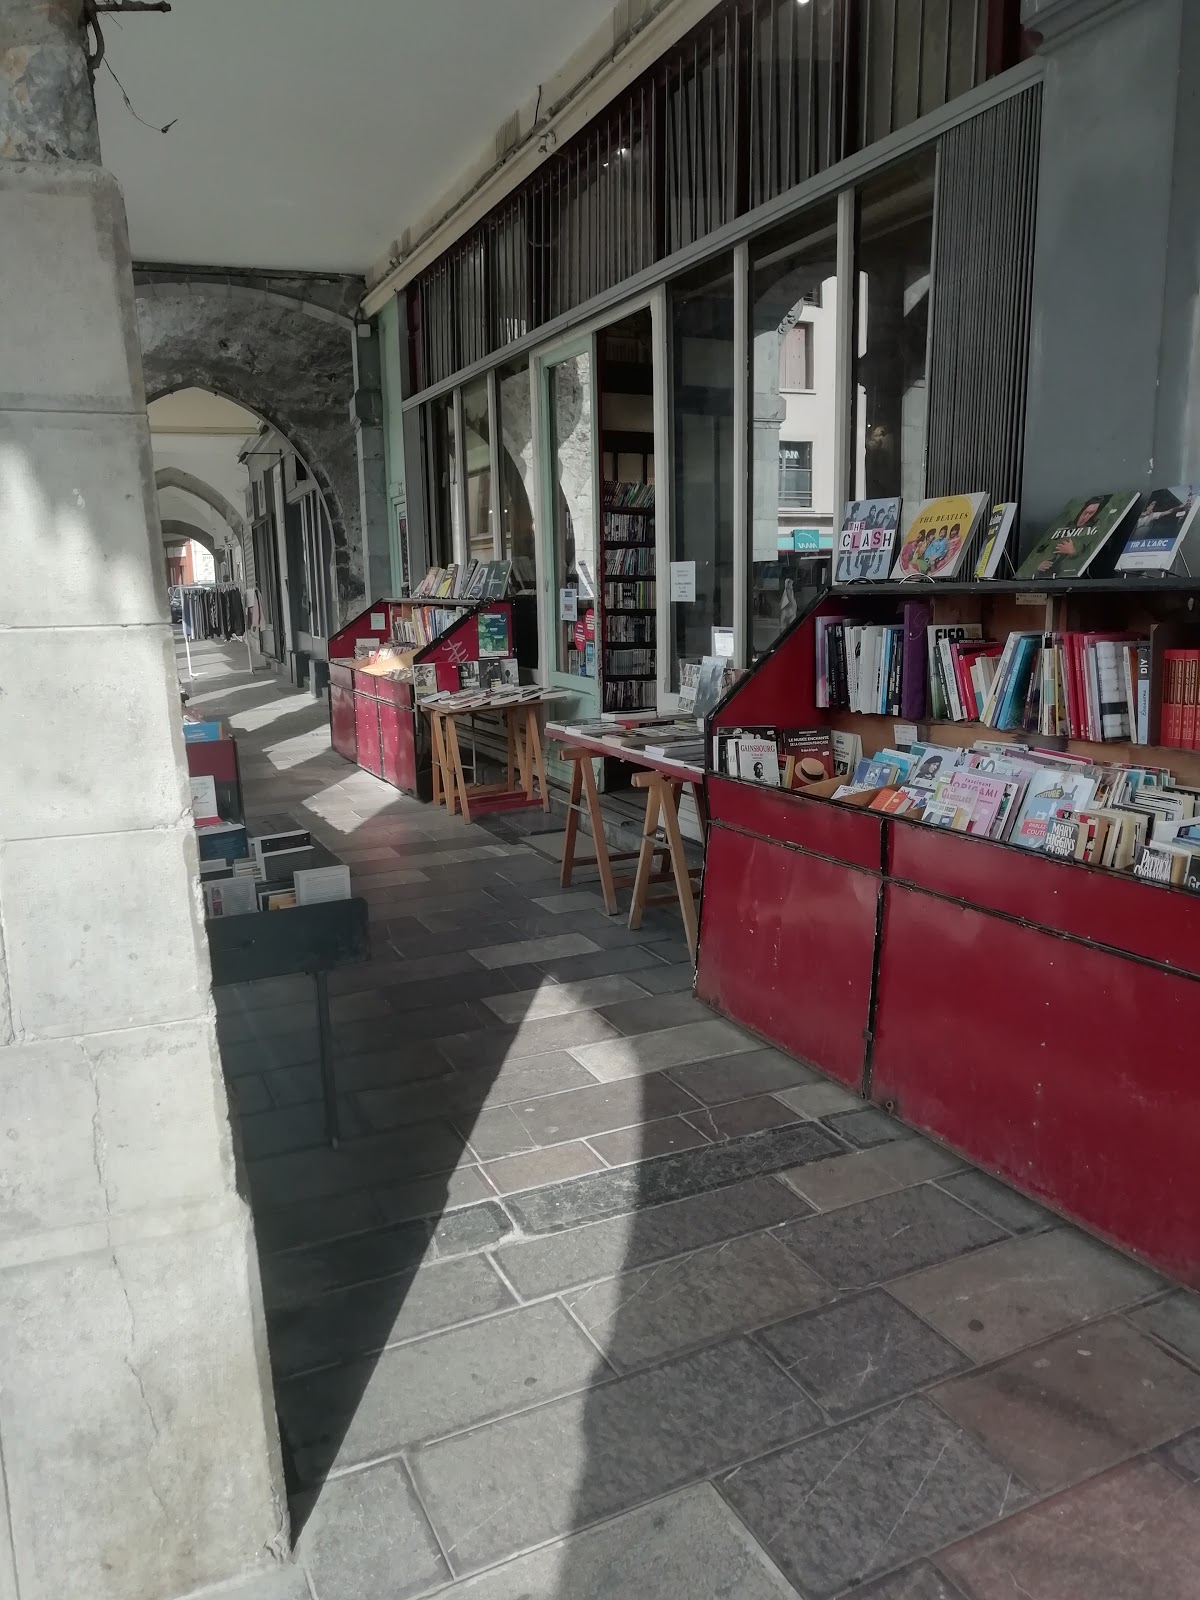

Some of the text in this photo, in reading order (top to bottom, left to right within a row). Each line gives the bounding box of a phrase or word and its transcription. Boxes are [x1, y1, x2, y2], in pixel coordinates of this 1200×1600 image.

[919, 513, 969, 524] THE BEATLES
[849, 522, 865, 532] THE
[842, 531, 892, 549] CLASH
[1147, 539, 1169, 548] L'ARC
[1140, 658, 1148, 674] DIY
[740, 744, 775, 753] GAINSBOURG
[965, 778, 992, 788] fascinant
[1051, 823, 1075, 838] MARY
[1045, 833, 1076, 851] HIGGINS
